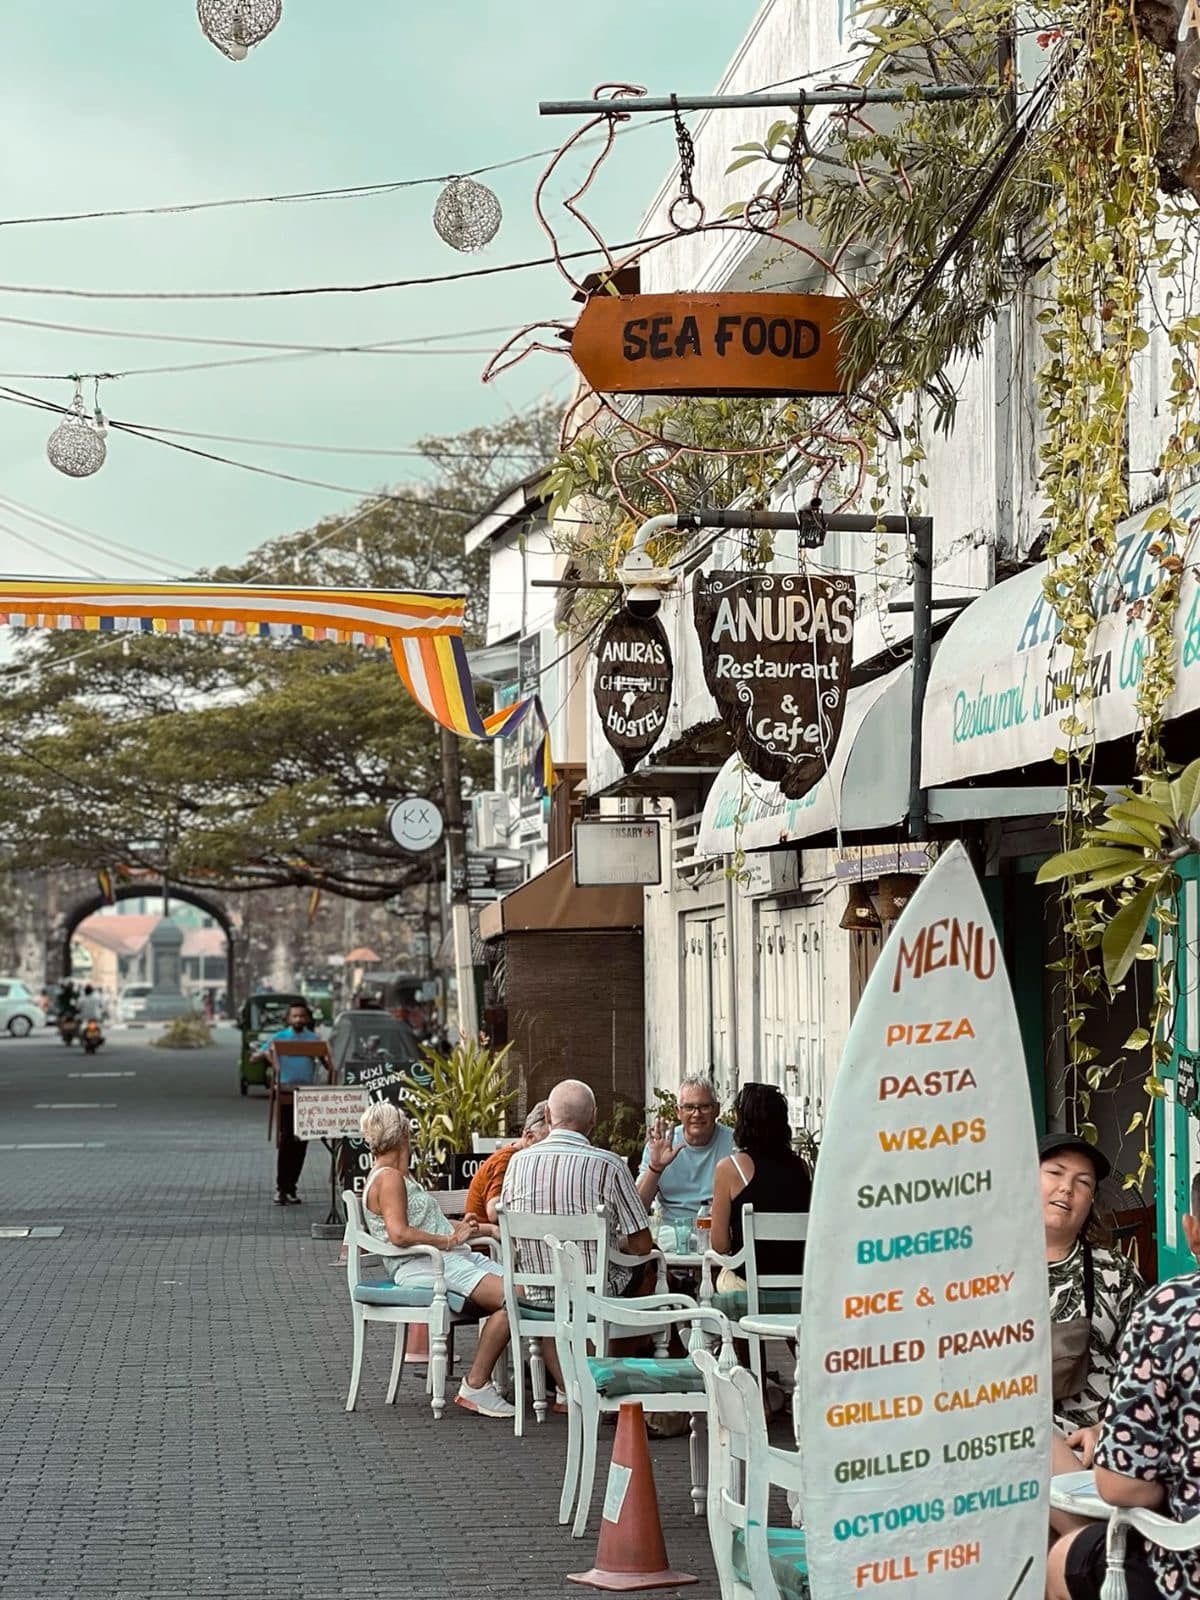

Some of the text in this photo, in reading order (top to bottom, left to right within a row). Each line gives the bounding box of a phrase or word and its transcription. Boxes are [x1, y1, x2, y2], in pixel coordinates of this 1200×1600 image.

[622, 315, 821, 361] SEA FOOD
[711, 586, 854, 644] ANURA'S
[602, 639, 665, 665] ANURA'S
[715, 653, 840, 682] Restaurant
[606, 705, 665, 738] HOSTEL
[780, 694, 799, 716] &
[755, 717, 821, 751] Cafe
[893, 918, 996, 992] MENU
[887, 1018, 976, 1047] PIZZA
[360, 1064, 384, 1081] KIXI
[879, 1069, 977, 1101] PASTA
[879, 1118, 988, 1152] WRAPS
[857, 1170, 993, 1209] SANDWICH
[857, 1226, 974, 1265] BURGERS
[845, 1271, 1016, 1319] RICE & CURRY
[825, 1319, 1036, 1374] GRILLED PRAWNS
[826, 1374, 1039, 1428] GRILLED CALAMARI
[835, 1427, 1036, 1484] GRILLED LOBSTER
[833, 1480, 1040, 1541] OCTOPUS DEVILLED
[856, 1542, 981, 1588] FULL FISH
